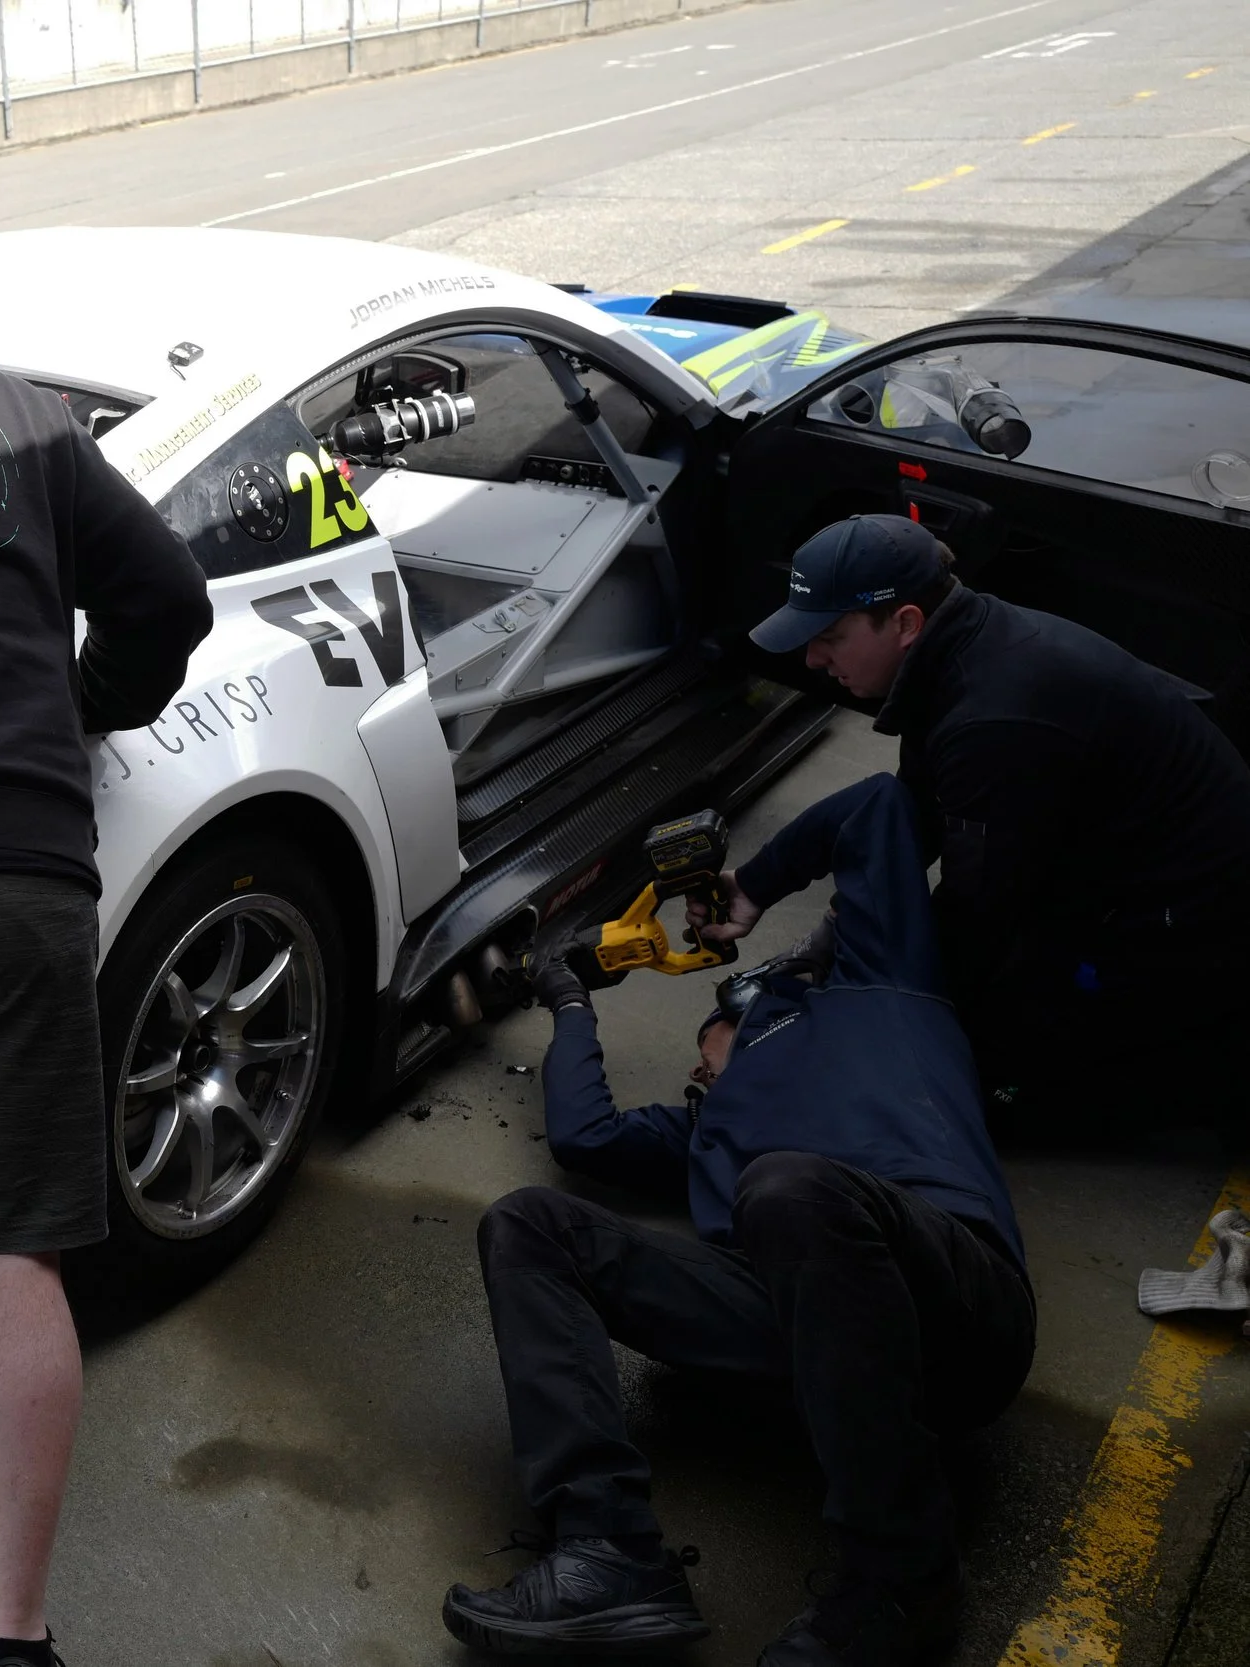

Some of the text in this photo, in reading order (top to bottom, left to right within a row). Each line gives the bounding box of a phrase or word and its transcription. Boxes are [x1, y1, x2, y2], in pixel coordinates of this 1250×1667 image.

[349, 276, 496, 329] JORDAN MICHELS
[135, 407, 216, 476] MANAGEMENT
[213, 373, 262, 417] SERVICES
